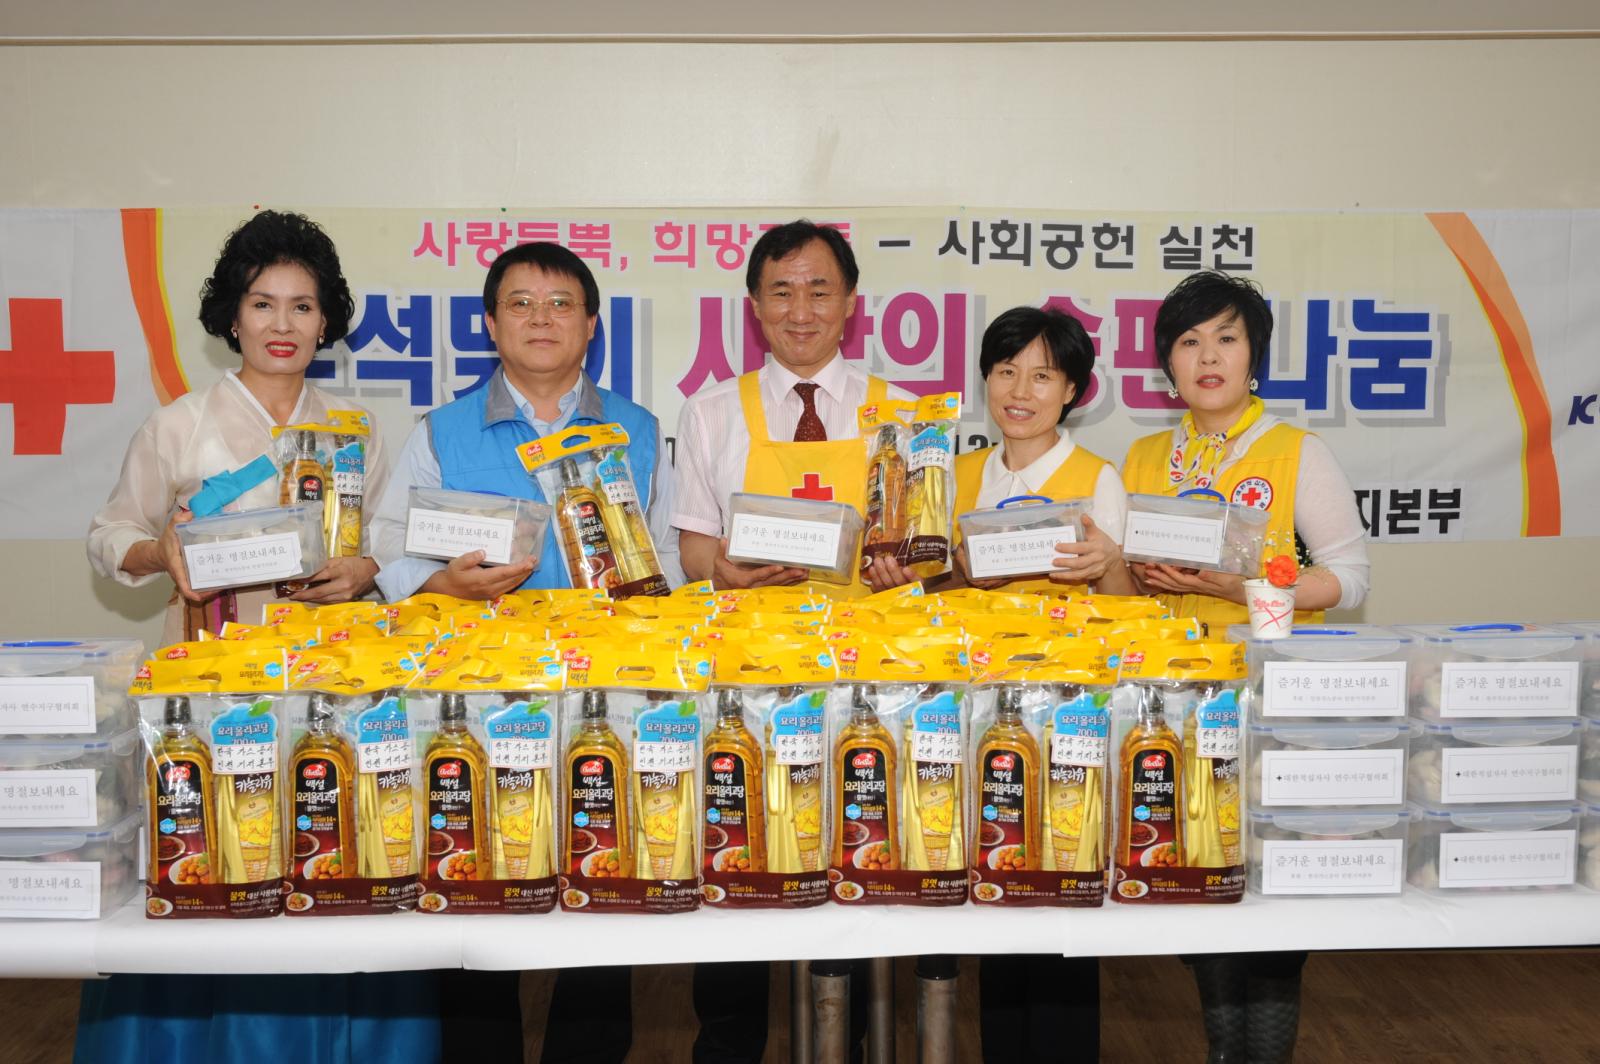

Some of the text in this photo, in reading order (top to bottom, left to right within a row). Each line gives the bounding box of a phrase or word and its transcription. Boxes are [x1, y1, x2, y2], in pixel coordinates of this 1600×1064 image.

[938, 219, 1135, 270] 사회공헌
[1159, 224, 1253, 271] 실천
[1278, 676, 1390, 689] 즐거운 명절보내세요
[1455, 676, 1564, 689] 즐거운 명절보내세요
[715, 773, 733, 784] 백설
[855, 768, 874, 780] 백설
[918, 763, 954, 781] 카놀라유
[993, 771, 1012, 783] 백설
[1145, 770, 1163, 781] 백설
[305, 779, 325, 791] 백설
[440, 778, 459, 790] 백설
[497, 772, 533, 791] 카놀라유
[582, 776, 602, 787] 백설
[844, 780, 885, 794] 요리올리고당
[1133, 781, 1174, 795] 요리올리고당
[4, 784, 79, 799] 명절보내세요
[572, 788, 614, 801] 요리올리고당
[705, 785, 744, 798] 요리올리고당
[983, 782, 1023, 796] 요리올리고당
[430, 790, 471, 804] 요리올리고당
[1275, 853, 1387, 868] 즐거운 명절보내세요
[8, 876, 83, 890] 명절보내세요
